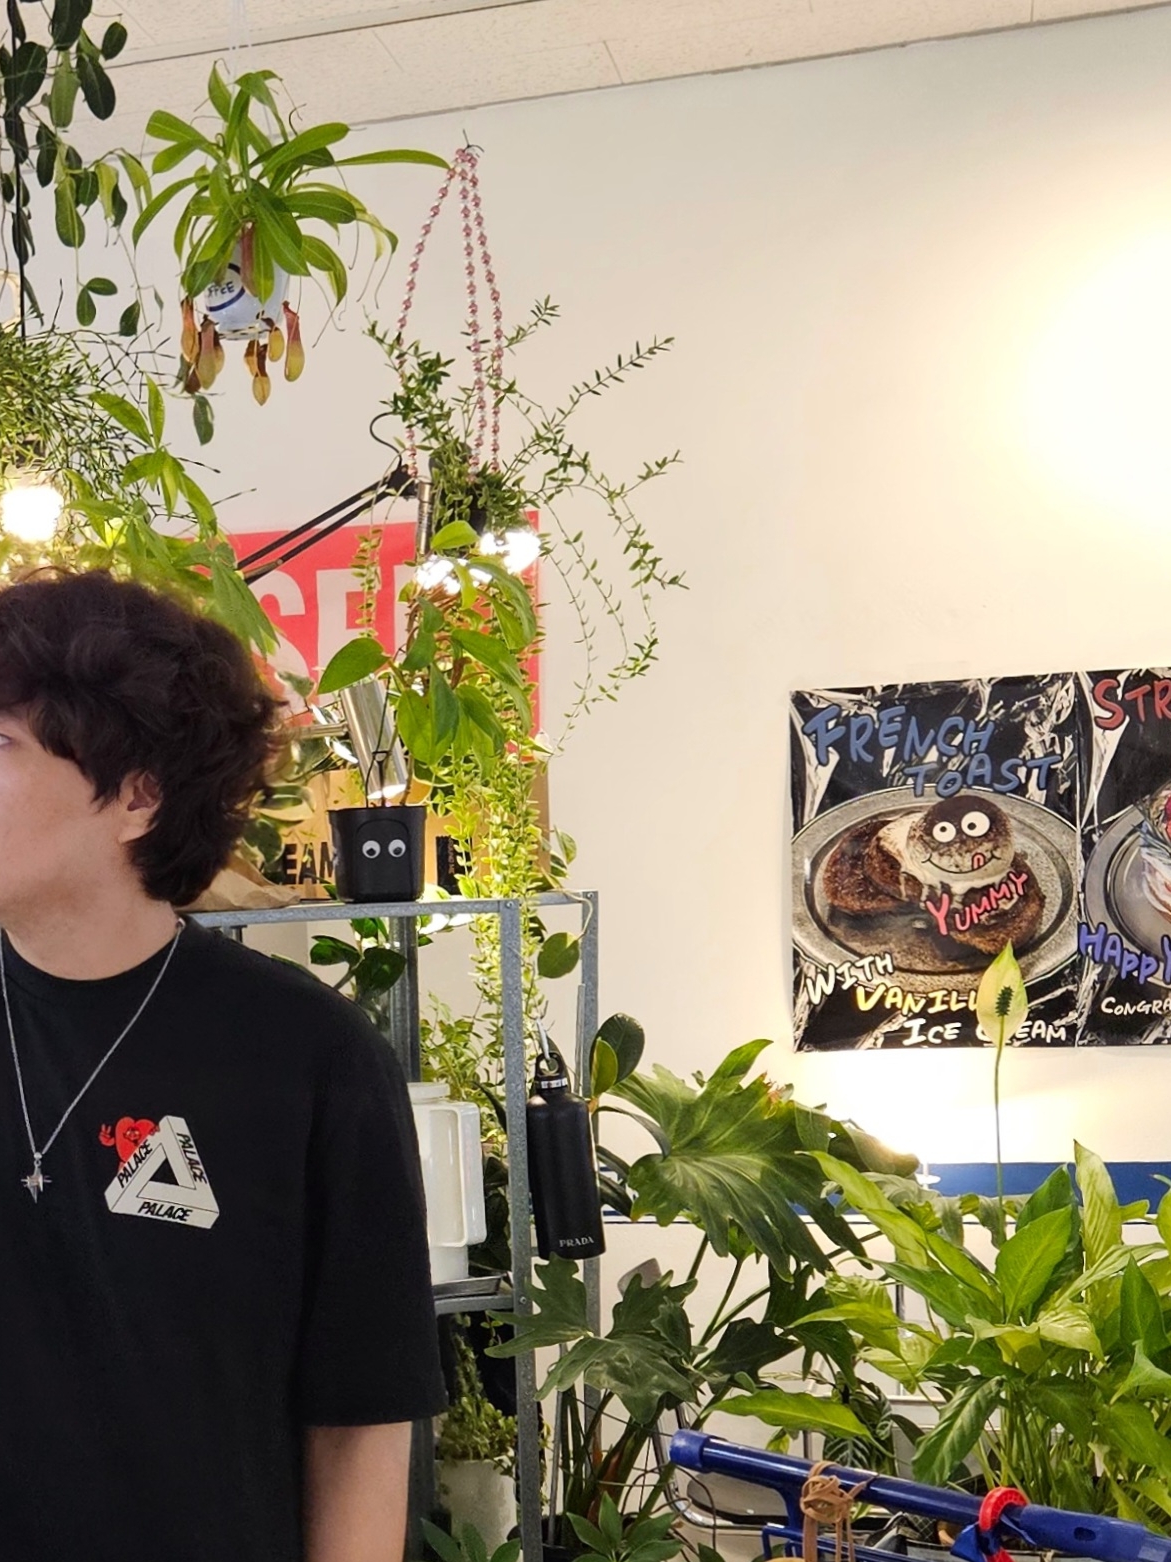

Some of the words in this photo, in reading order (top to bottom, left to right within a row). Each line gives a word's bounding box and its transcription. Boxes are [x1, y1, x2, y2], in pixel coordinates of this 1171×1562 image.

[803, 705, 995, 767] FRENCH
[903, 753, 1062, 798] TOAST
[926, 870, 1028, 935] YUMMY
[805, 951, 895, 1006] WITH
[902, 1018, 961, 1046] ICE
[117, 1139, 153, 1189] PALACE
[176, 1132, 208, 1184] PALACE
[137, 1201, 193, 1221] PALACE
[559, 1236, 595, 1248] PRADA
